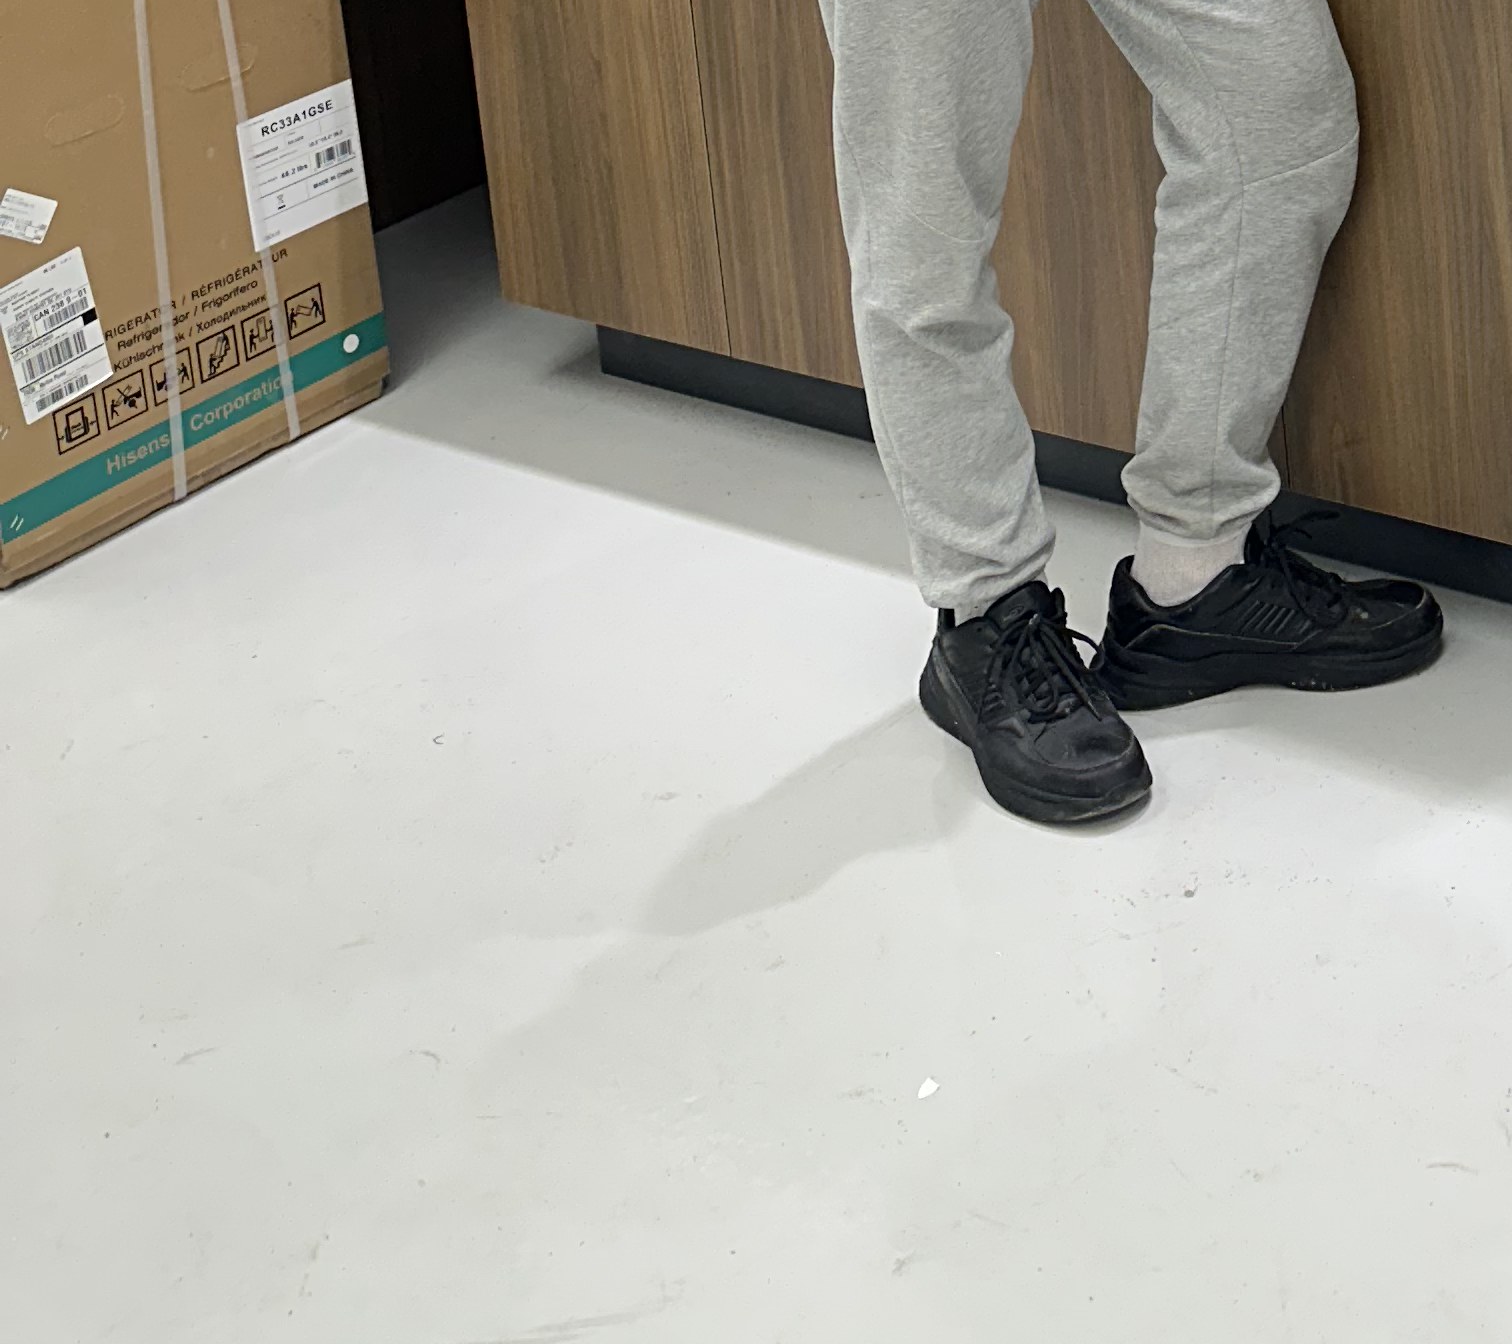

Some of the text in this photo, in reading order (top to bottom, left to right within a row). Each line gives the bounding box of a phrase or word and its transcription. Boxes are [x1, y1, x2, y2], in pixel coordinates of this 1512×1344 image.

[261, 100, 335, 137] RC33A1GSE
[105, 300, 177, 342] RIGERATR
[191, 248, 289, 302] RÉFRIGÉRATUR
[34, 308, 50, 322] CAN
[117, 312, 190, 351] Refrigerdor
[113, 332, 185, 372] Kühlschrk
[106, 376, 283, 476] Hisens Corporatio
